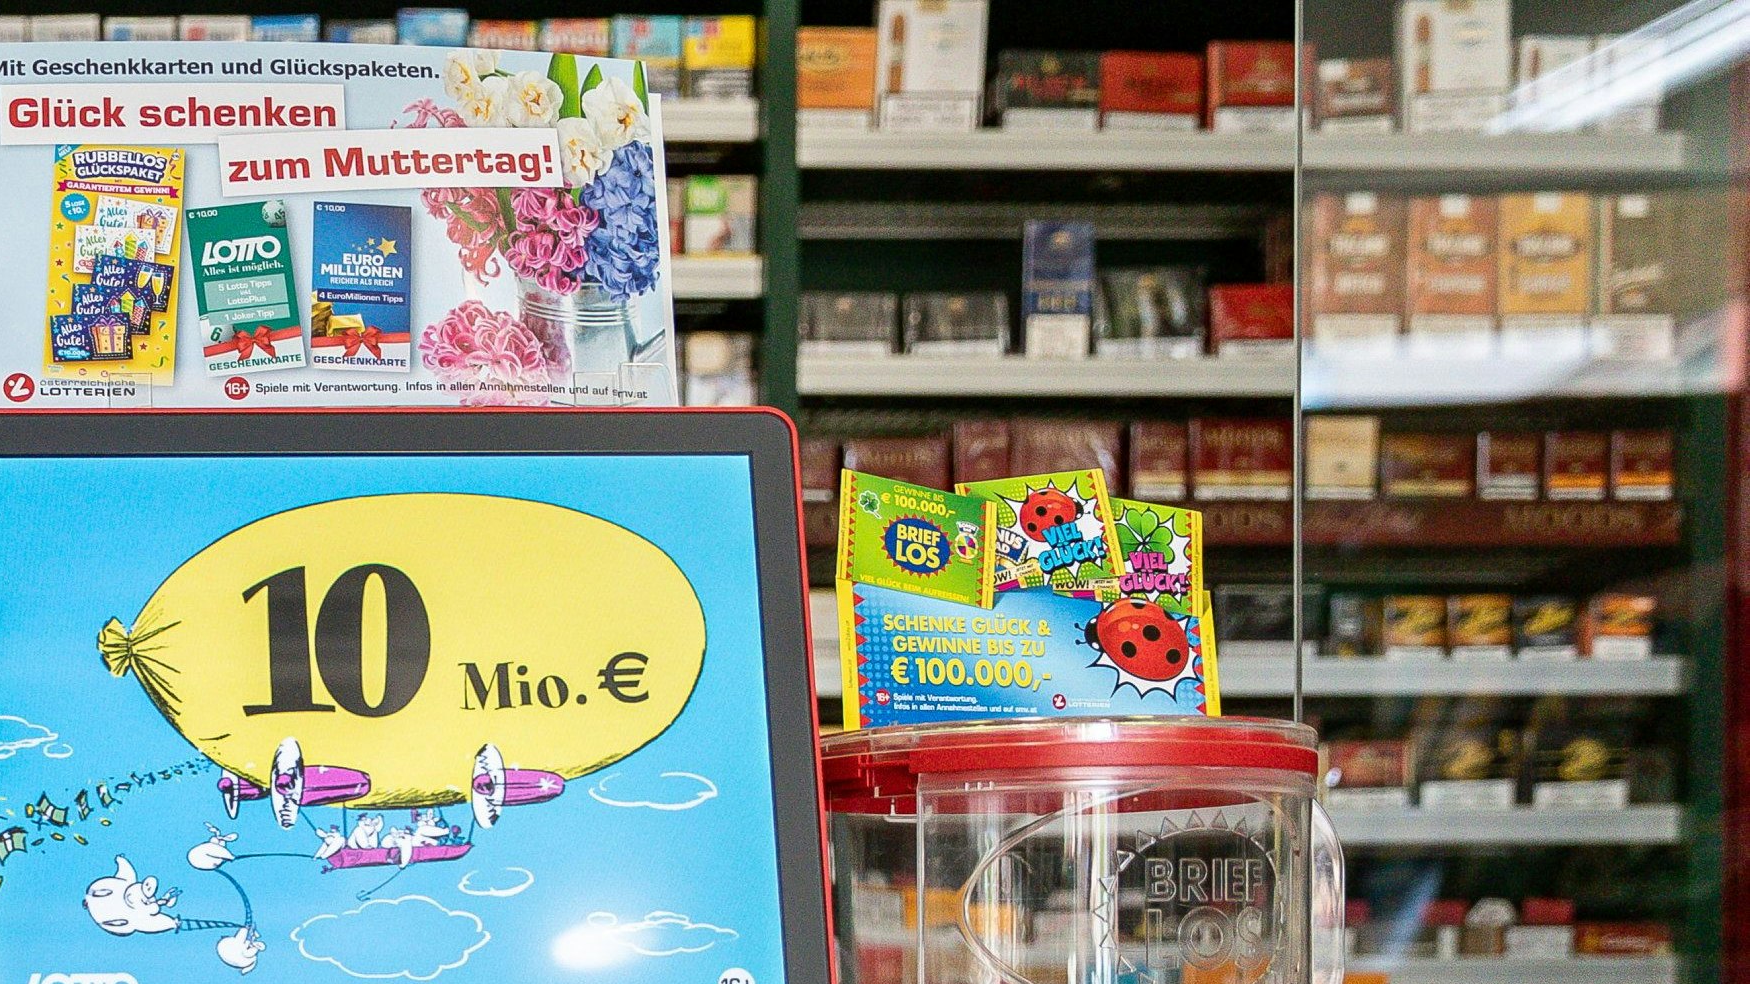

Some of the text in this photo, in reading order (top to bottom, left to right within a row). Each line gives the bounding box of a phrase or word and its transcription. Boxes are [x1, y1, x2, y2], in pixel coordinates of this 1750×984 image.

[33, 59, 213, 77] Geschenkkarten
[221, 59, 262, 76] und
[270, 58, 440, 83] Glückspaketen.
[8, 96, 336, 128] Glück schenken
[73, 150, 167, 170] RUBBELLOS
[228, 145, 552, 188] zum Muttertag!
[77, 163, 163, 181] GLÜCKSPAKET
[201, 235, 282, 267] LOTTO
[342, 253, 384, 267] EURO
[103, 265, 125, 276] Alles
[202, 261, 284, 278] Alles ist möglich.
[320, 263, 403, 279] MILLIONEN
[226, 282, 247, 291] Lotto
[248, 279, 273, 290] Tipps
[330, 277, 394, 287] REICHER ALS REICH
[82, 294, 104, 306] Alles
[227, 295, 267, 305] LottoPlus
[326, 292, 381, 302] EuroMillionen
[381, 295, 404, 304] Tipps
[231, 311, 255, 322] Joker
[257, 309, 275, 320] Tipp
[61, 323, 82, 337] Alles
[55, 334, 86, 347] Gute!
[208, 354, 302, 371] GESCHENKKARTE
[313, 355, 407, 367] GESCHENKKARTE
[40, 386, 136, 397] LOTTERIEN
[225, 381, 609, 396] 16+ Spiele mit Verantwortung. Infos in allen Annahmestellen und auf
[893, 484, 945, 502] GEWINNE BIS
[881, 492, 956, 518] € 100.000,-
[896, 523, 941, 547] BRIEF
[1041, 522, 1083, 548] VIEL
[895, 541, 941, 569] LOS
[1038, 536, 1106, 573] GLÜCK!
[1129, 551, 1168, 572] VIEL
[1054, 579, 1089, 590] WOW!
[1119, 568, 1190, 595] GLÜCK!
[883, 613, 1052, 636] SCHENKE GLÜCK &
[241, 563, 649, 717] 10 Mio. €
[892, 636, 1046, 657] GEWINNE BIS ZU
[890, 656, 1052, 692] € 100.000,-
[893, 693, 913, 703] Spiele
[914, 694, 926, 702] mit
[927, 694, 978, 704] Verantwortung.
[893, 703, 909, 711] Infos
[1145, 858, 1263, 902] BRIEF
[1146, 906, 1270, 971] LOS
